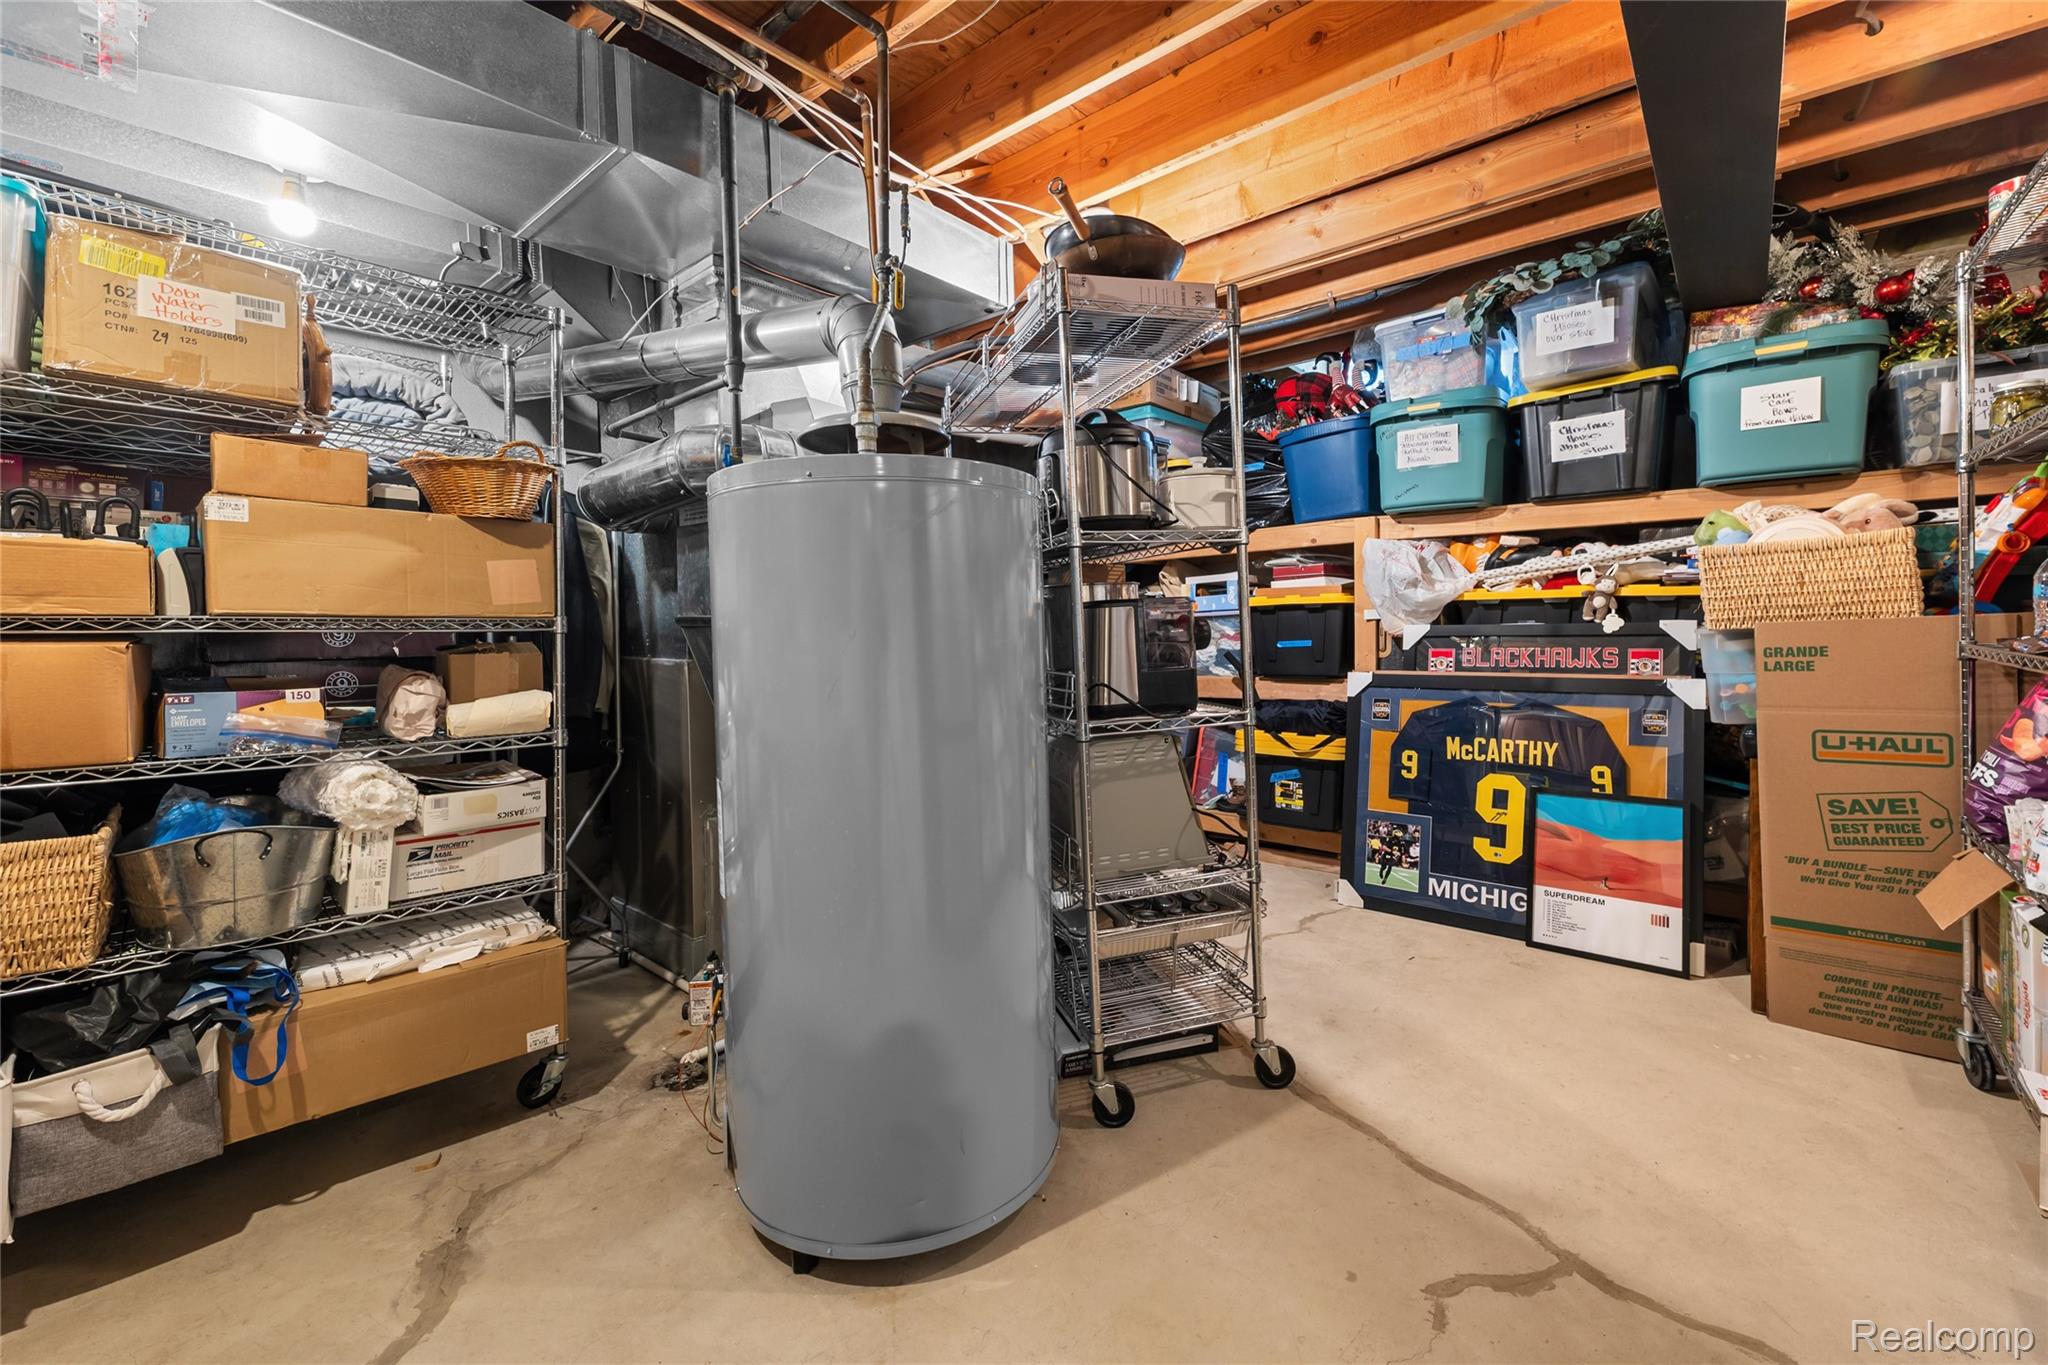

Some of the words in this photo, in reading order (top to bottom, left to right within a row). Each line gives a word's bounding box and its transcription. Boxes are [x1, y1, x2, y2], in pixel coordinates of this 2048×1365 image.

[151, 292, 219, 312] Water
[104, 309, 128, 320] PO#
[153, 305, 223, 328] Holders
[180, 336, 198, 346] 125
[1461, 647, 1619, 669] BLACKHAWKS
[1763, 646, 1829, 658] GRANDE
[1764, 661, 1815, 672] LARGE
[290, 690, 311, 700] 150
[170, 718, 207, 728] ENVELOPES
[1446, 736, 1559, 767] McCARTHY
[1821, 735, 1944, 754] U-HAUL
[1401, 750, 1418, 779] 9
[1590, 765, 1613, 794] 9
[1827, 798, 1919, 816] SAVE!
[1473, 773, 1527, 865] 9
[1831, 823, 1872, 834] BEST
[1874, 823, 1922, 834] PRICE
[434, 851, 453, 859] MAIL
[1811, 859, 1820, 867] A
[1800, 875, 1825, 885] We'll
[1828, 879, 1850, 889] Give
[1854, 881, 1873, 891] You
[1815, 868, 1839, 878] Beat
[1842, 871, 1860, 880] Our
[1864, 873, 1903, 886] Bundle
[1544, 890, 1605, 906] SUPERDREAM
[1848, 928, 1927, 947] uhaul.com
[1824, 973, 1869, 988] COMPRE
[1872, 981, 1888, 991] UN
[1819, 991, 1871, 1009] Encuentre
[1874, 1003, 1888, 1011] un
[1891, 1006, 1923, 1018] mejor
[1809, 1007, 1853, 1022] daremos
[1876, 1021, 1890, 1029] en
[1823, 1002, 1842, 1013] que
[1845, 1006, 1885, 1020] nuestro
[1889, 1015, 1934, 1029] paquete
[1938, 1023, 1945, 1032] y
